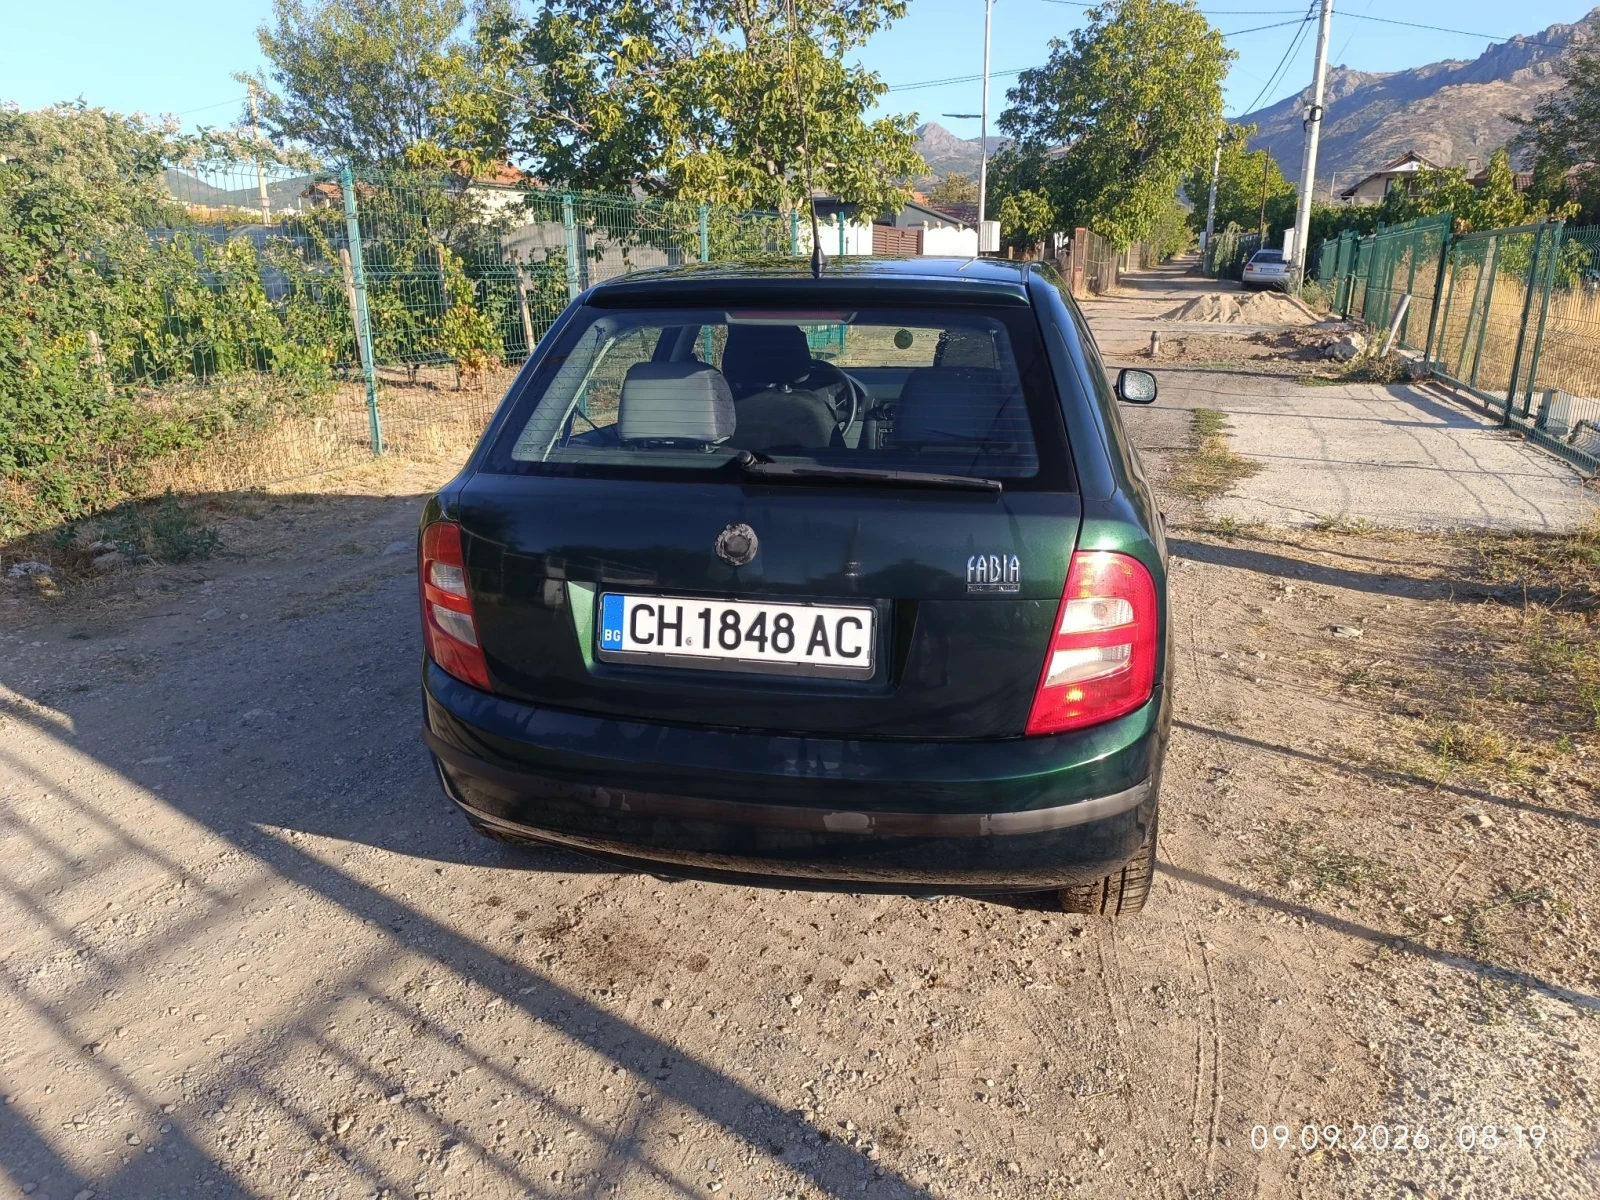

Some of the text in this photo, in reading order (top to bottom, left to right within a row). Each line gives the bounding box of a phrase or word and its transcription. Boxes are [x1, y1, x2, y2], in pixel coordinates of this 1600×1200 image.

[966, 554, 1020, 583] FABIA
[604, 628, 621, 642] BG
[630, 603, 863, 659] CH 1848 AC
